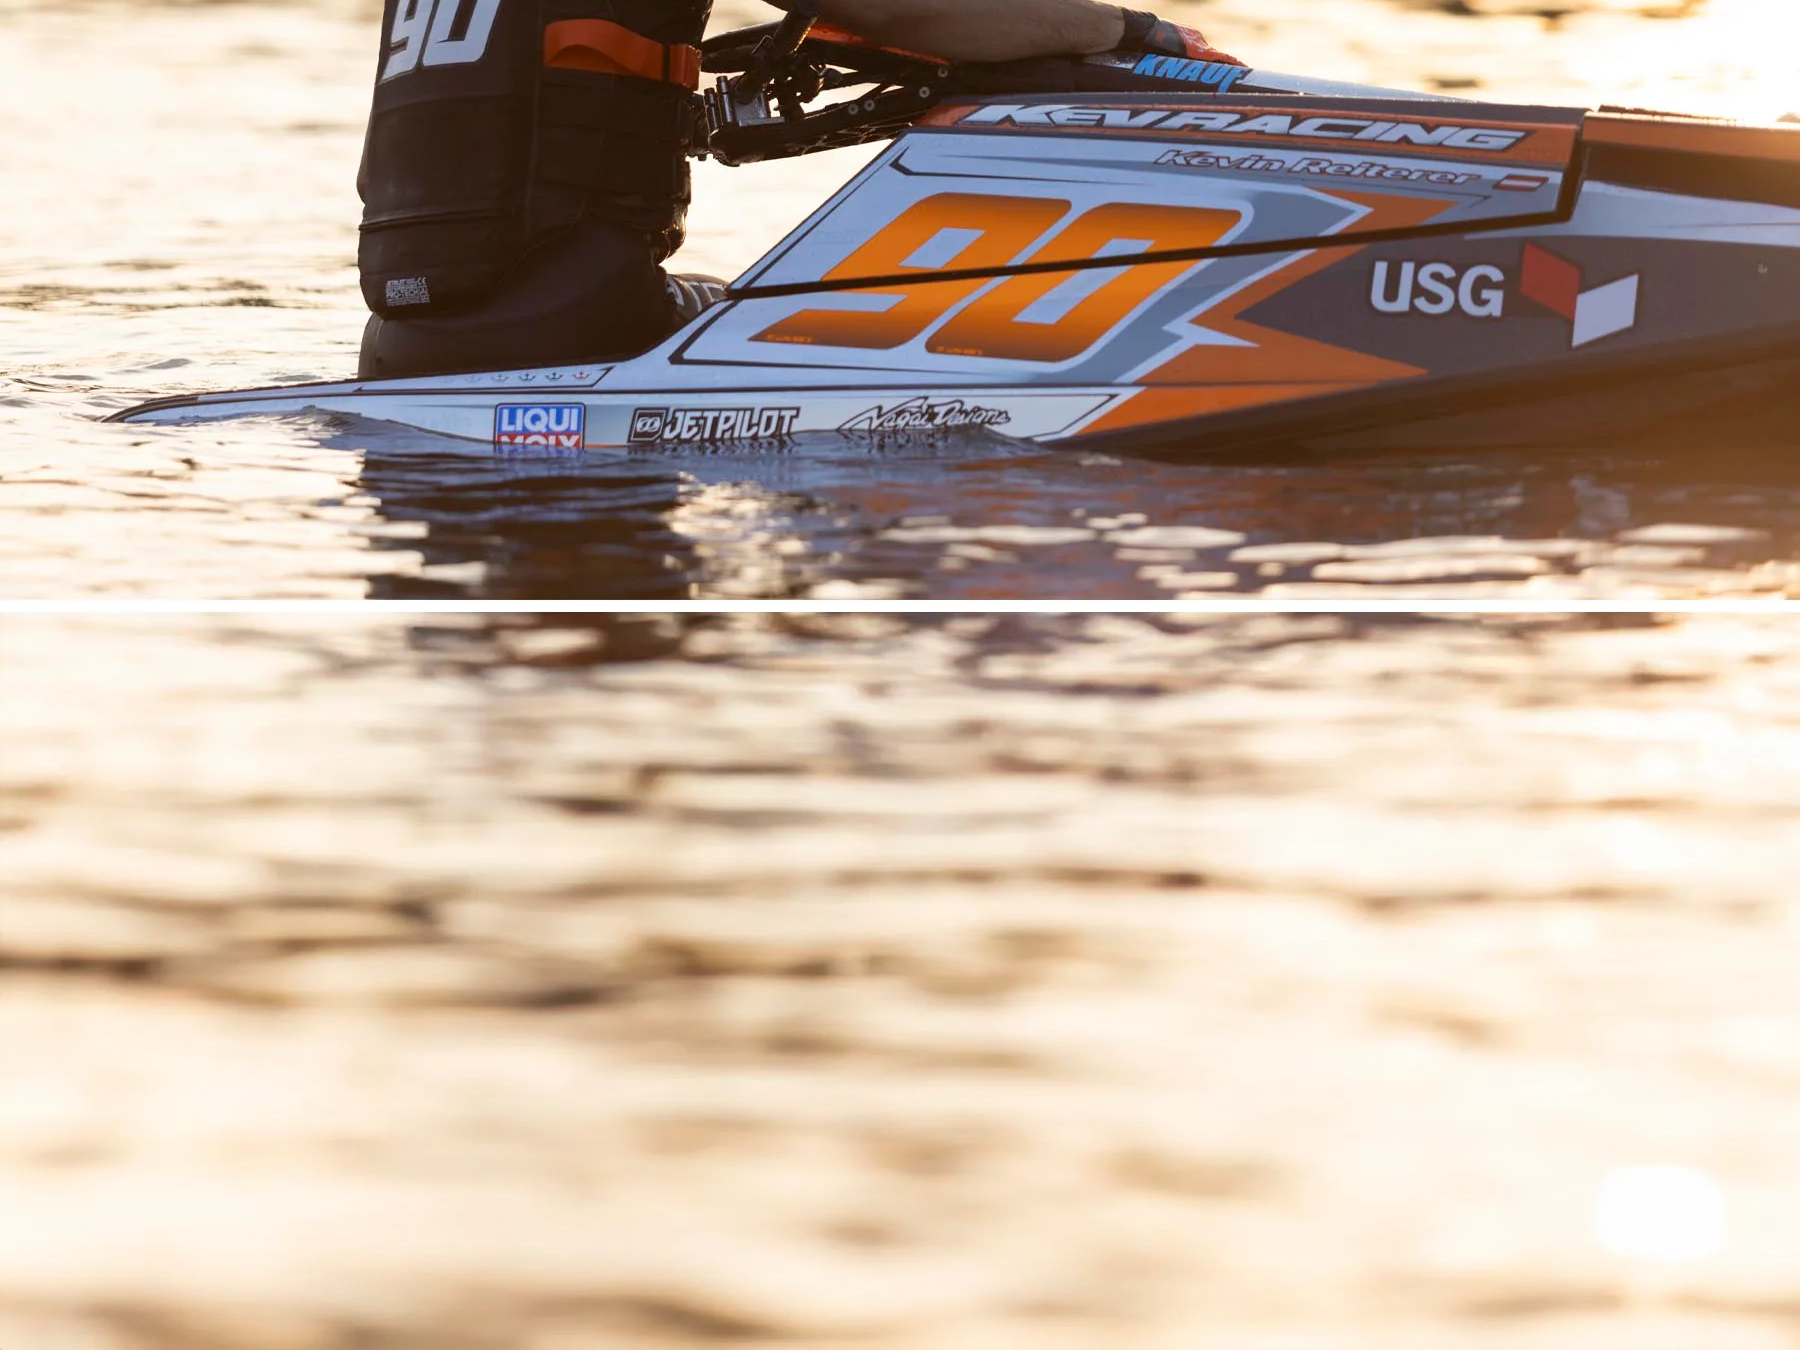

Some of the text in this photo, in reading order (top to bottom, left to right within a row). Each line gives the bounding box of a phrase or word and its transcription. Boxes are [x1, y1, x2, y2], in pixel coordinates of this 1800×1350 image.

[1133, 53, 1251, 94] KNAUF
[1153, 150, 1483, 185] Kevin Reiterer
[747, 191, 1242, 363] 90
[1370, 260, 1505, 318] USG
[502, 407, 579, 432] LIQUI
[663, 408, 799, 440] JETPILOT
